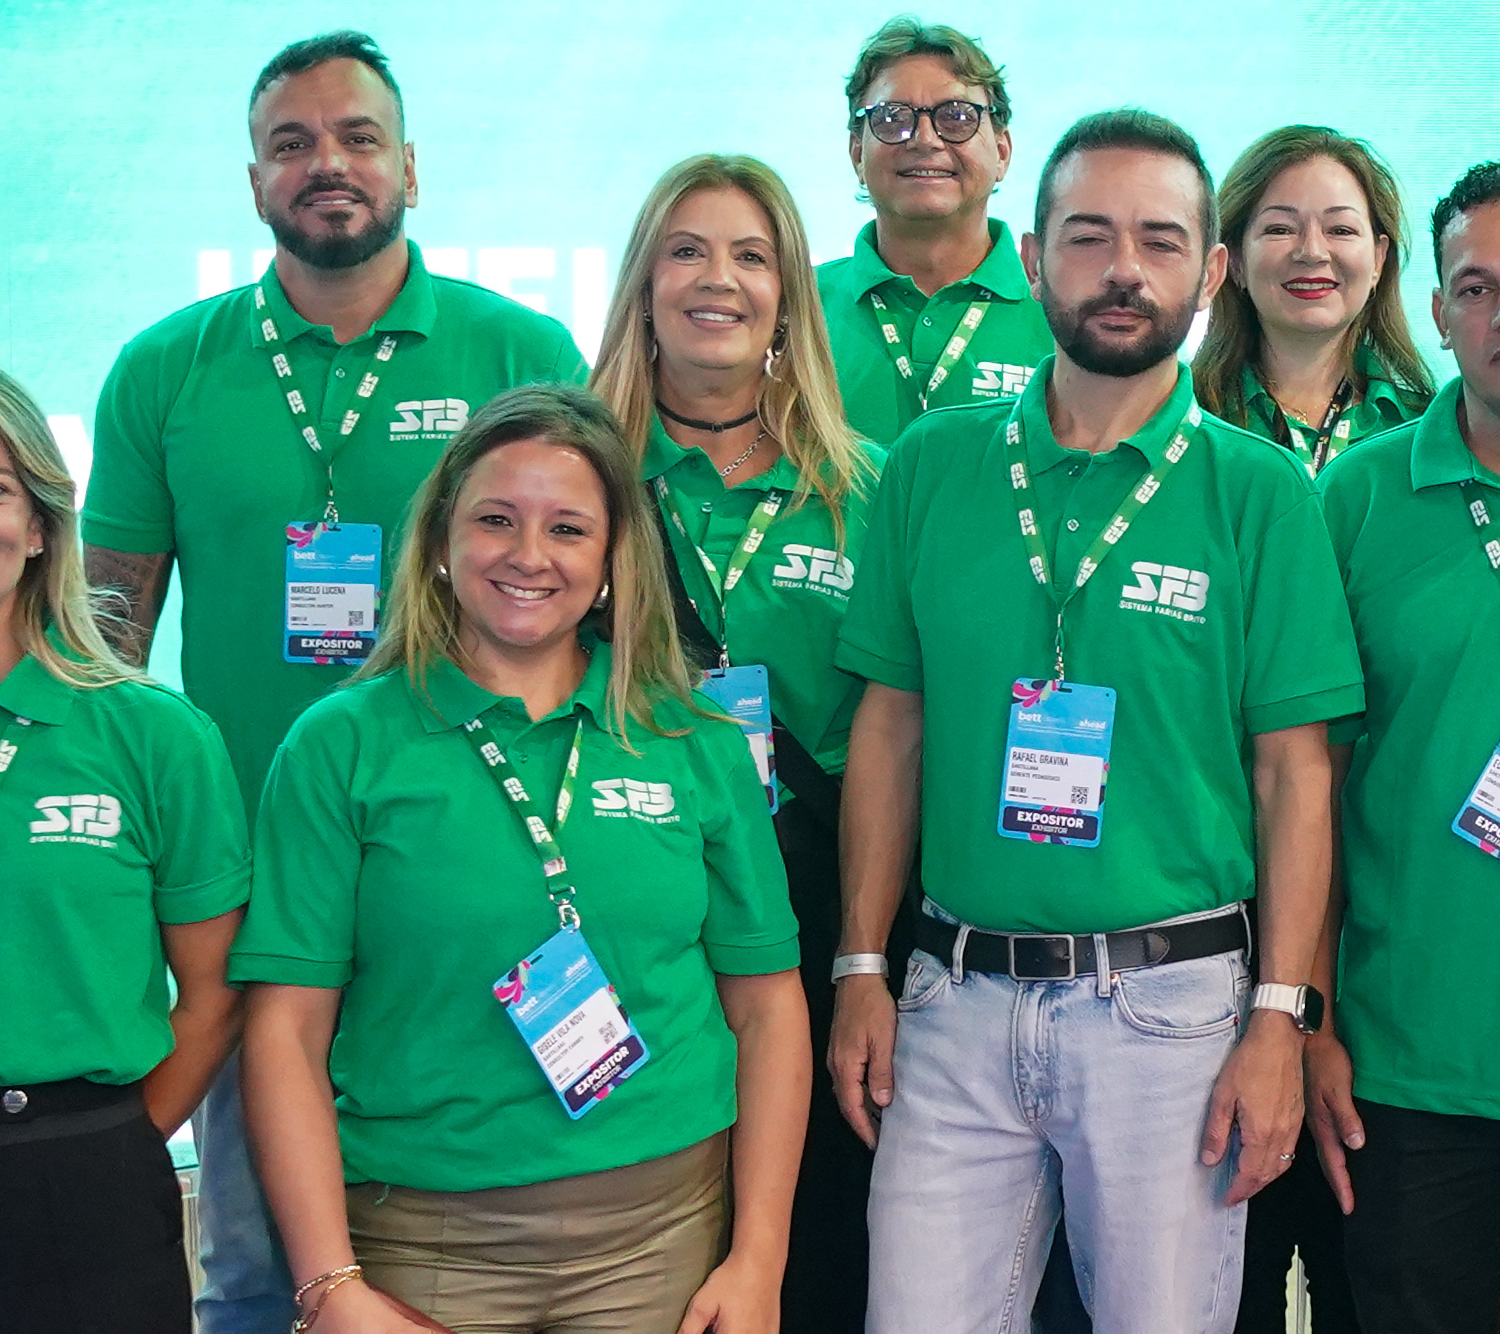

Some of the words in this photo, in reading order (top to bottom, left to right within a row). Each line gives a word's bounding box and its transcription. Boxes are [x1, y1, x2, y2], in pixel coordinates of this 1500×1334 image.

[390, 398, 469, 431] SFB
[774, 544, 854, 591] SFB
[1122, 561, 1210, 612] SFB
[1119, 601, 1152, 612] SISTEMA
[301, 639, 363, 649] EXPOSITOR
[1012, 751, 1037, 763] RAFAEL
[1039, 755, 1069, 766] GRAVINA
[592, 778, 675, 815] SFB
[30, 794, 122, 838] SFB
[1017, 811, 1084, 829] EXPOSITOR
[574, 1046, 630, 1096] EXPOSITOR
